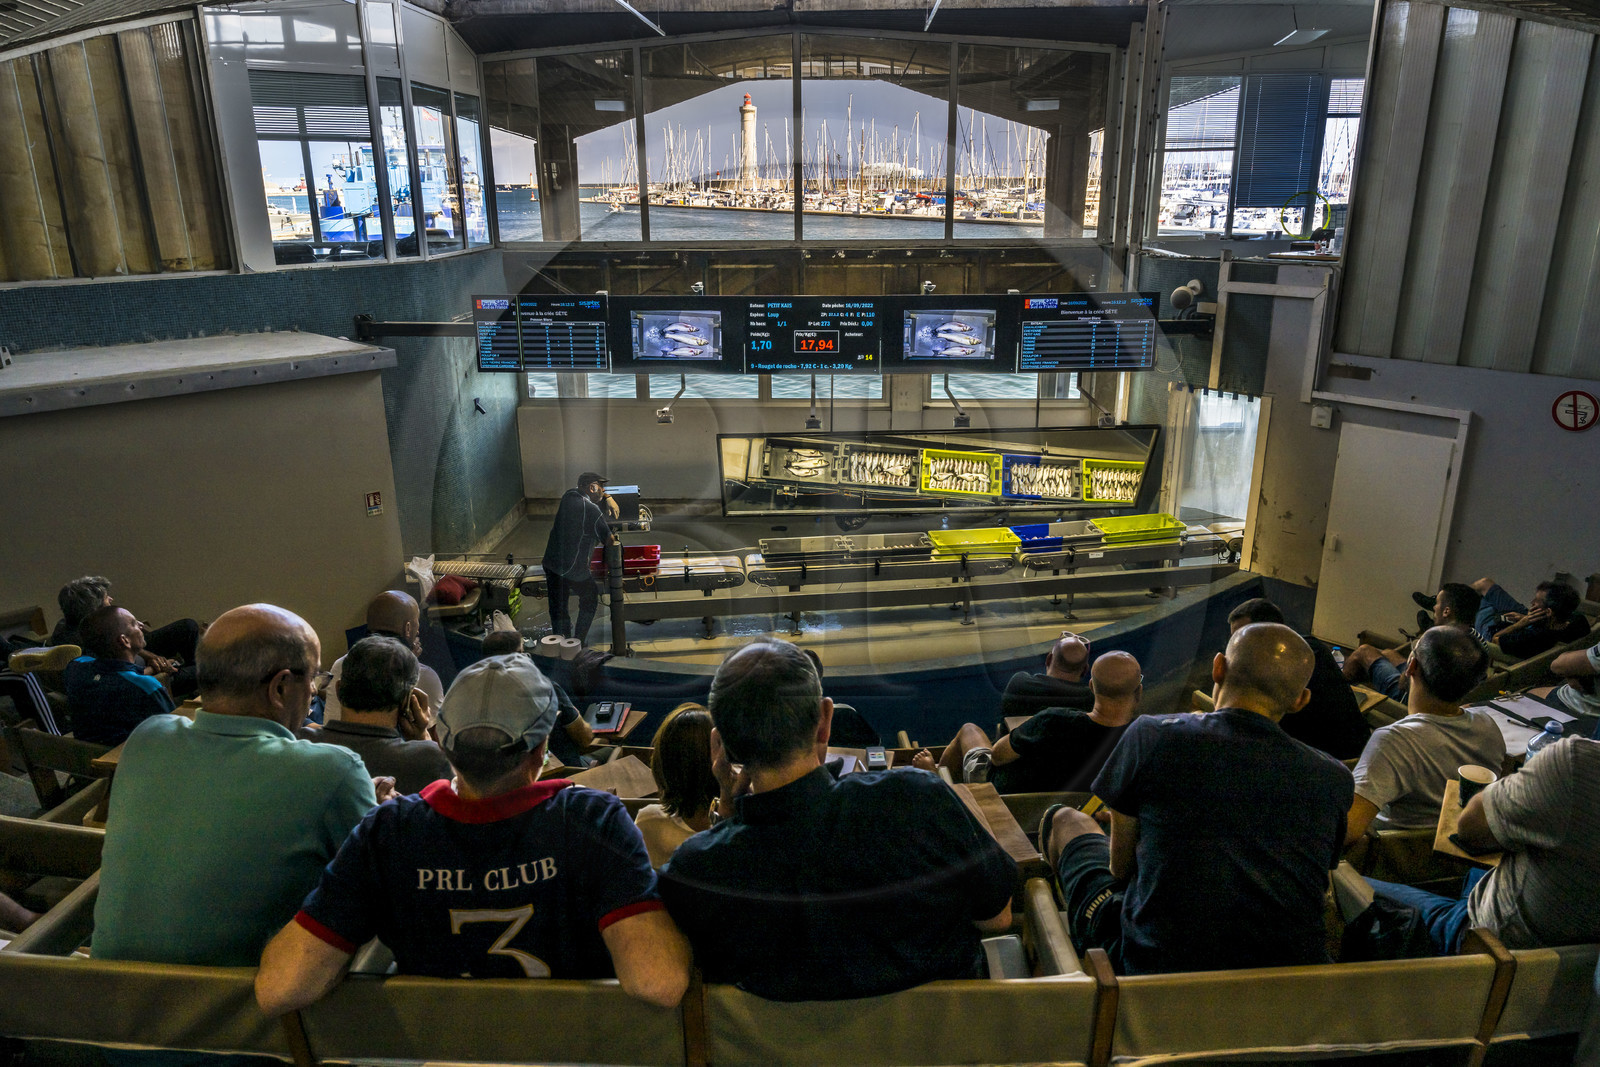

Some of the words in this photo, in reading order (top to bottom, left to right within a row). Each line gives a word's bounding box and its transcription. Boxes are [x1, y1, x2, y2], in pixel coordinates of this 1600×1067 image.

[751, 340, 772, 351] 1,70
[800, 340, 834, 352] 17,94
[416, 868, 472, 890] PRL
[484, 857, 558, 891] CLUB
[449, 904, 551, 978] 3
